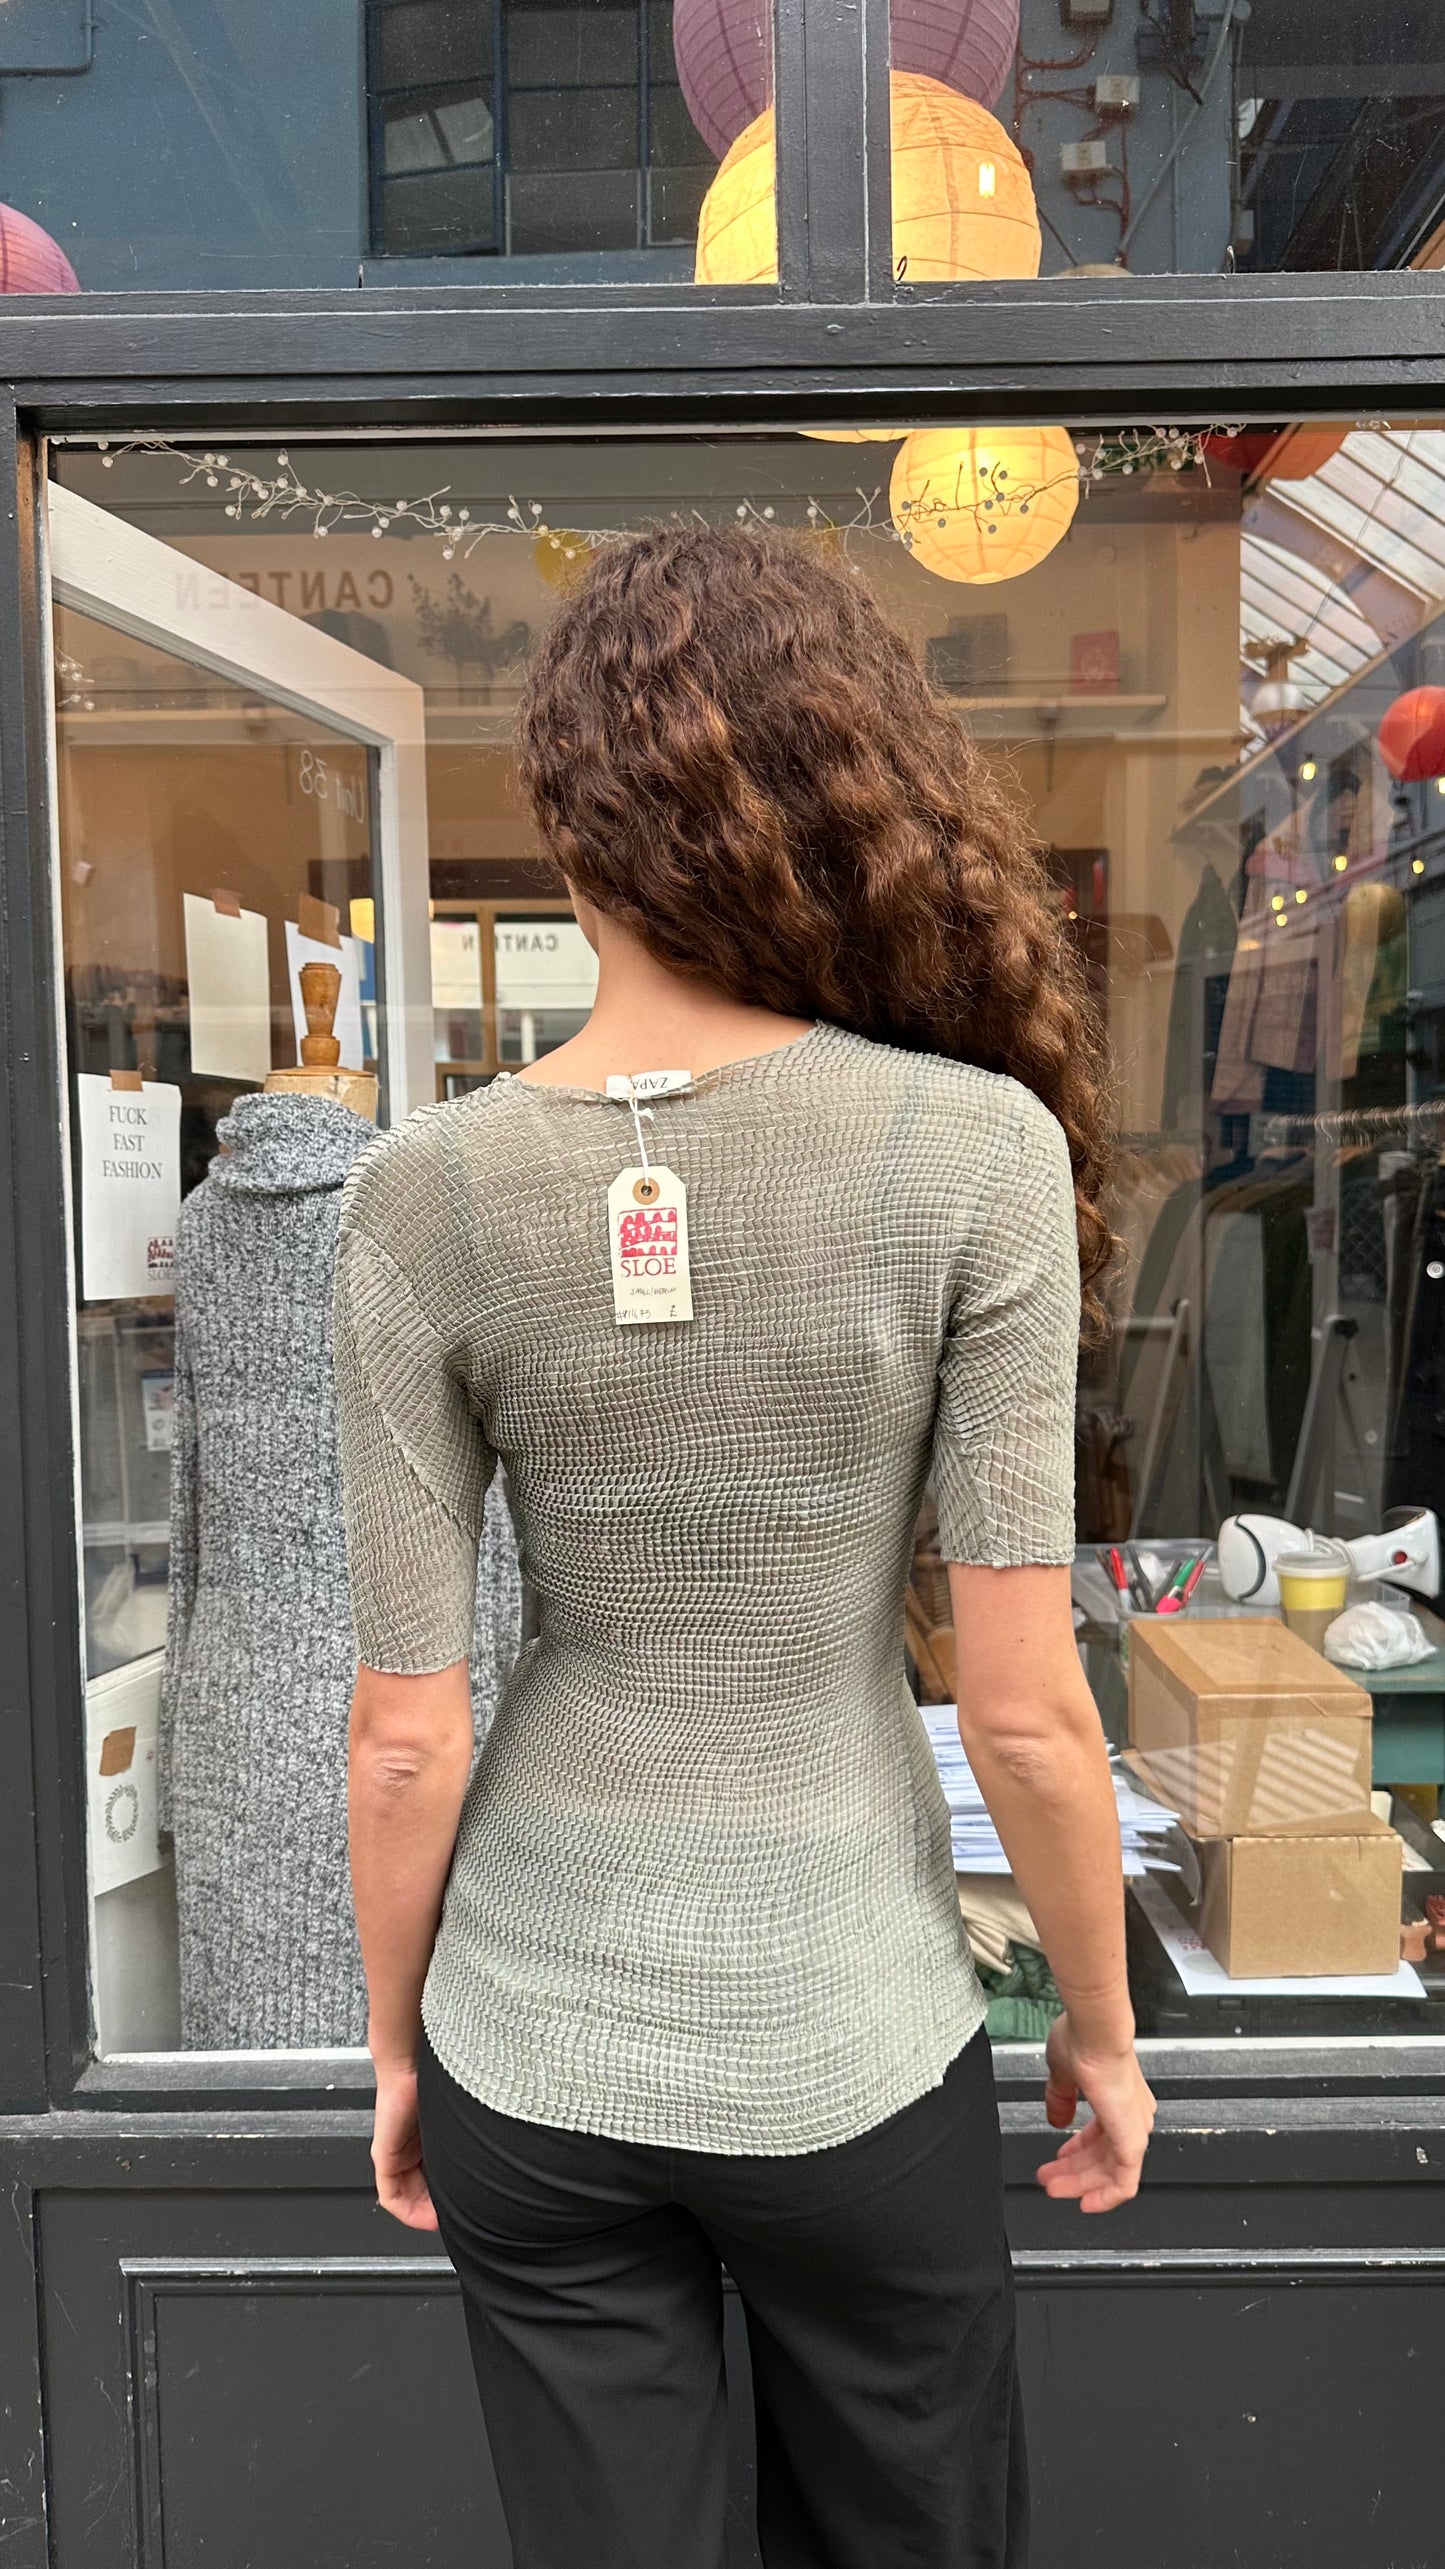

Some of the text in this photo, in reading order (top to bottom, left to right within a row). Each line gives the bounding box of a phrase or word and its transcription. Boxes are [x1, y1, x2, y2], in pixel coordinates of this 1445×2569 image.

[630, 1077, 669, 1090] ZAPA
[109, 1105, 148, 1126] FUCK
[113, 1132, 146, 1152] FAST
[102, 1159, 163, 1180] FASHION
[620, 1257, 677, 1278] SLOE
